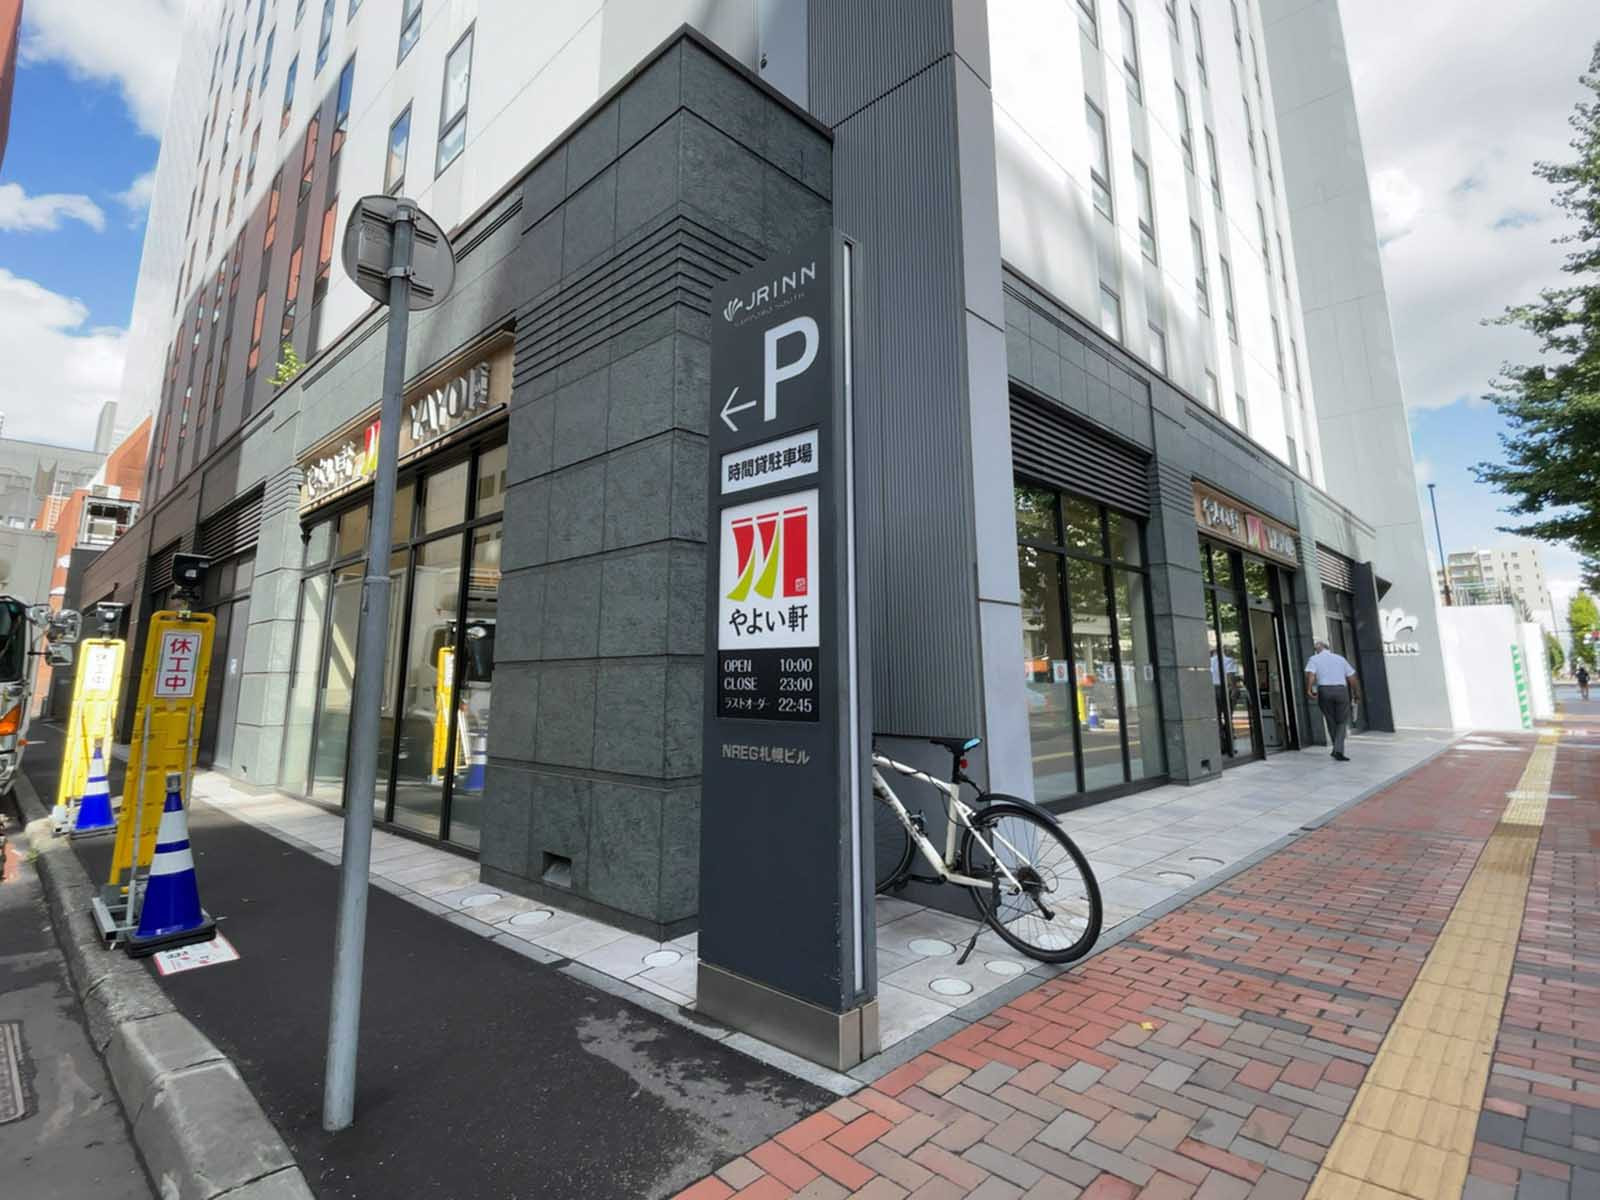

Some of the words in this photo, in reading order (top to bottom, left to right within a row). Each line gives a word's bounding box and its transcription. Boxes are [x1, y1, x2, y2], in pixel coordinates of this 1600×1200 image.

[764, 316, 820, 422] P
[727, 442, 813, 481] 時間貸駐車場
[729, 604, 808, 636] やよい軒
[165, 638, 193, 691] 休工中
[724, 659, 752, 673] OPEN
[780, 658, 813, 673] 10:00
[724, 677, 758, 690] CLOSE
[779, 677, 814, 691] 23:00
[778, 697, 813, 713] 22:45
